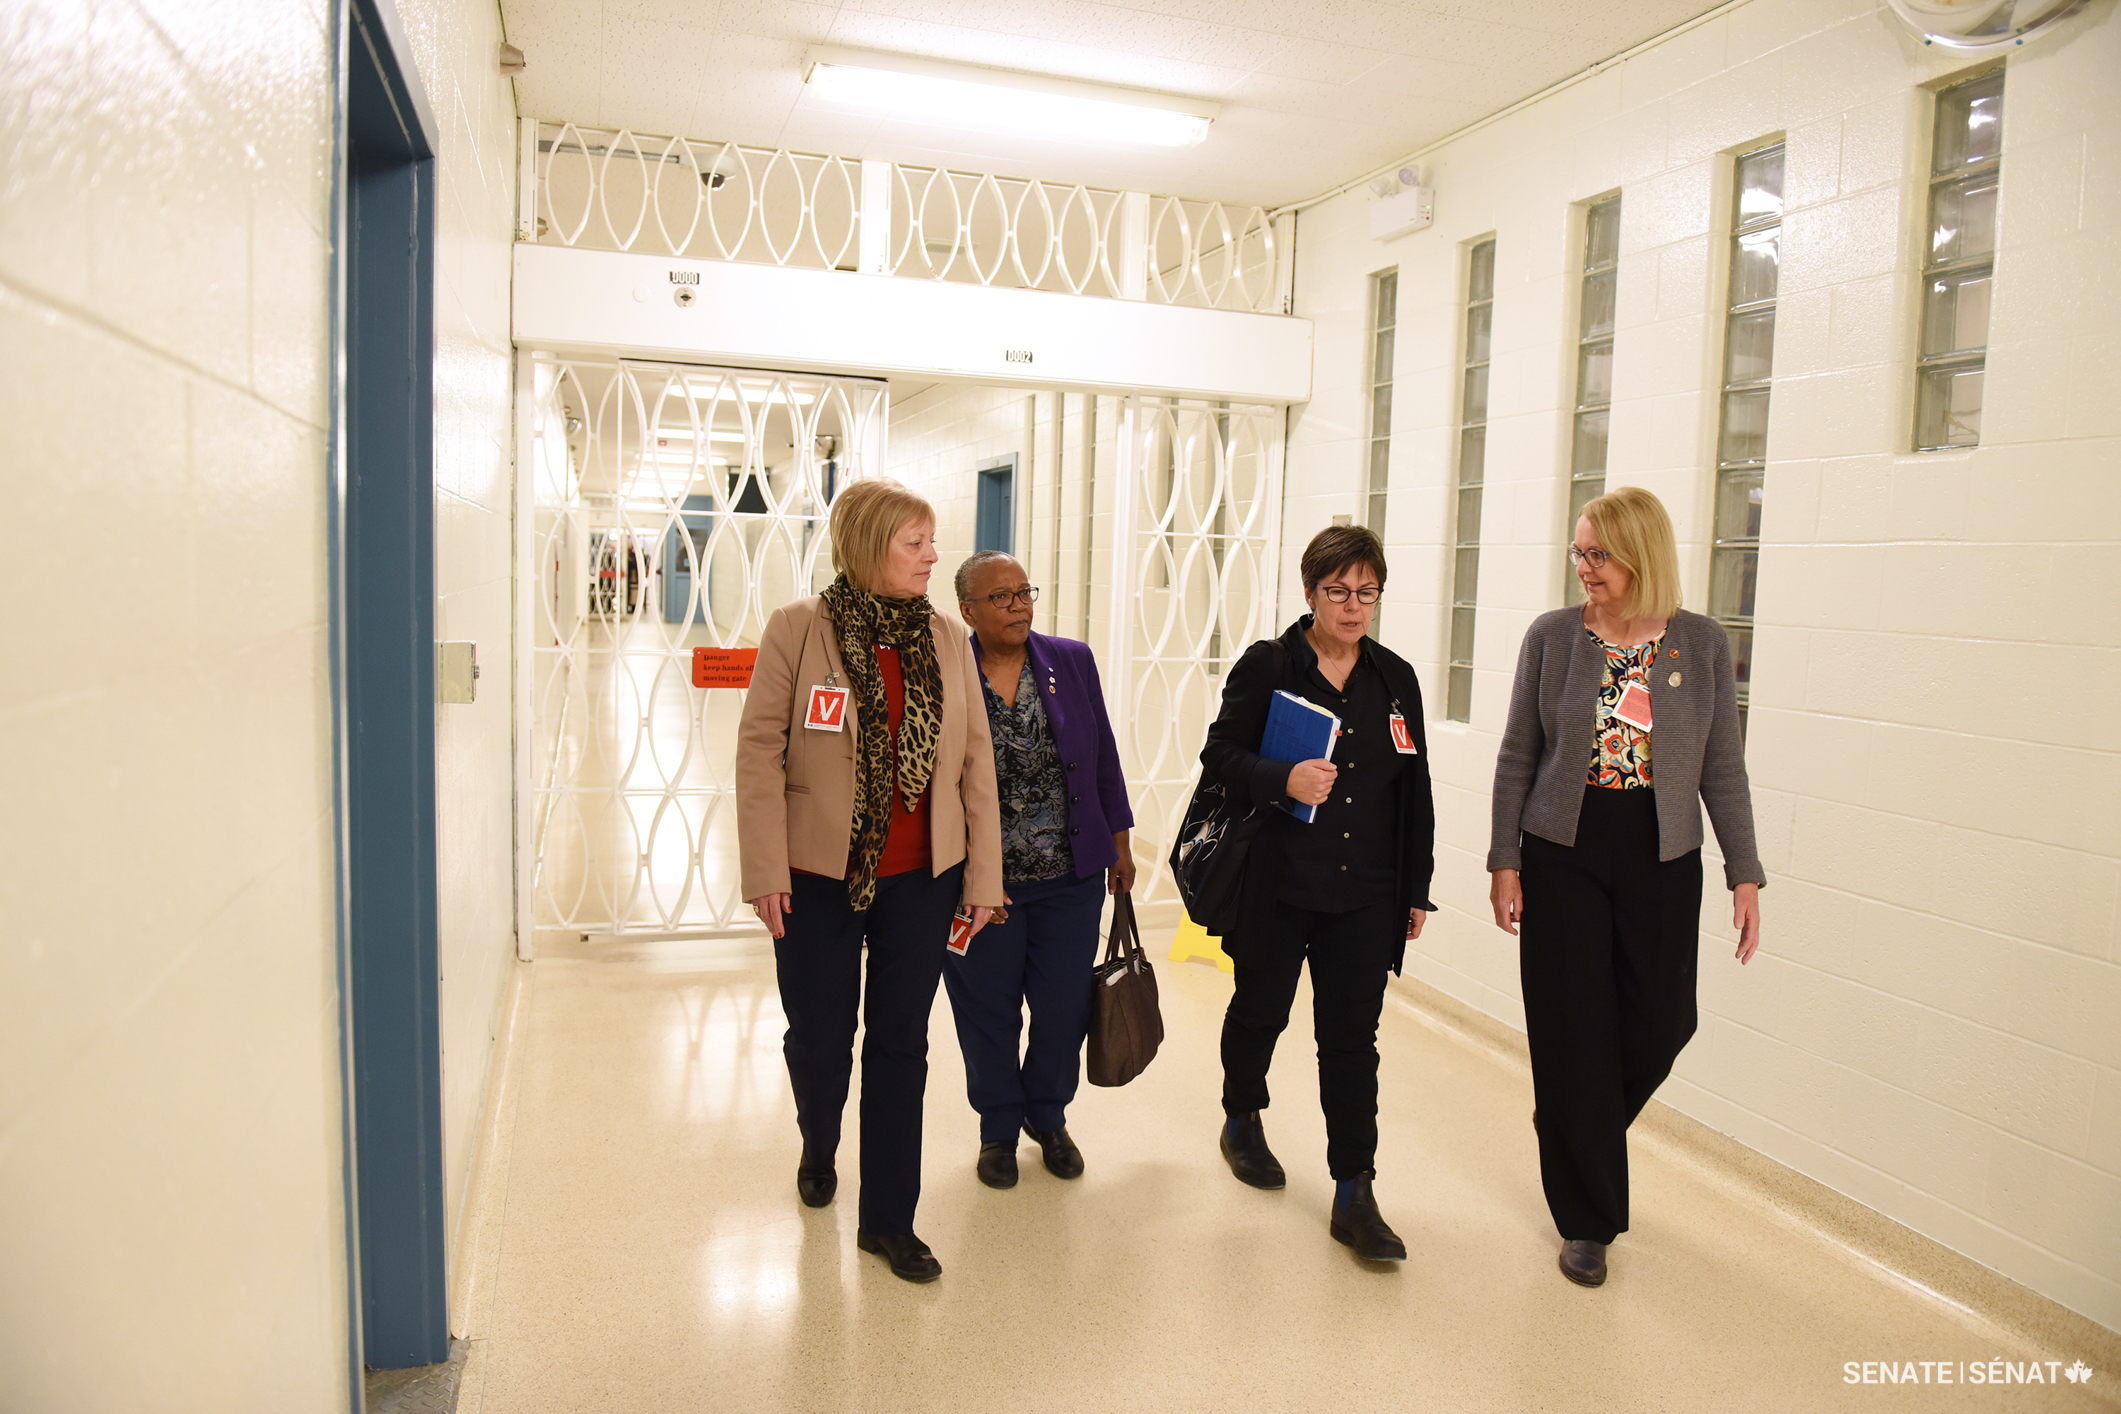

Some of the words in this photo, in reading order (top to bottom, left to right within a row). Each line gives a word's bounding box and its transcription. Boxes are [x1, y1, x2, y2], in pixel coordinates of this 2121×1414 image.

[819, 695, 840, 722] V
[1394, 723, 1408, 746] V
[949, 922, 967, 943] V
